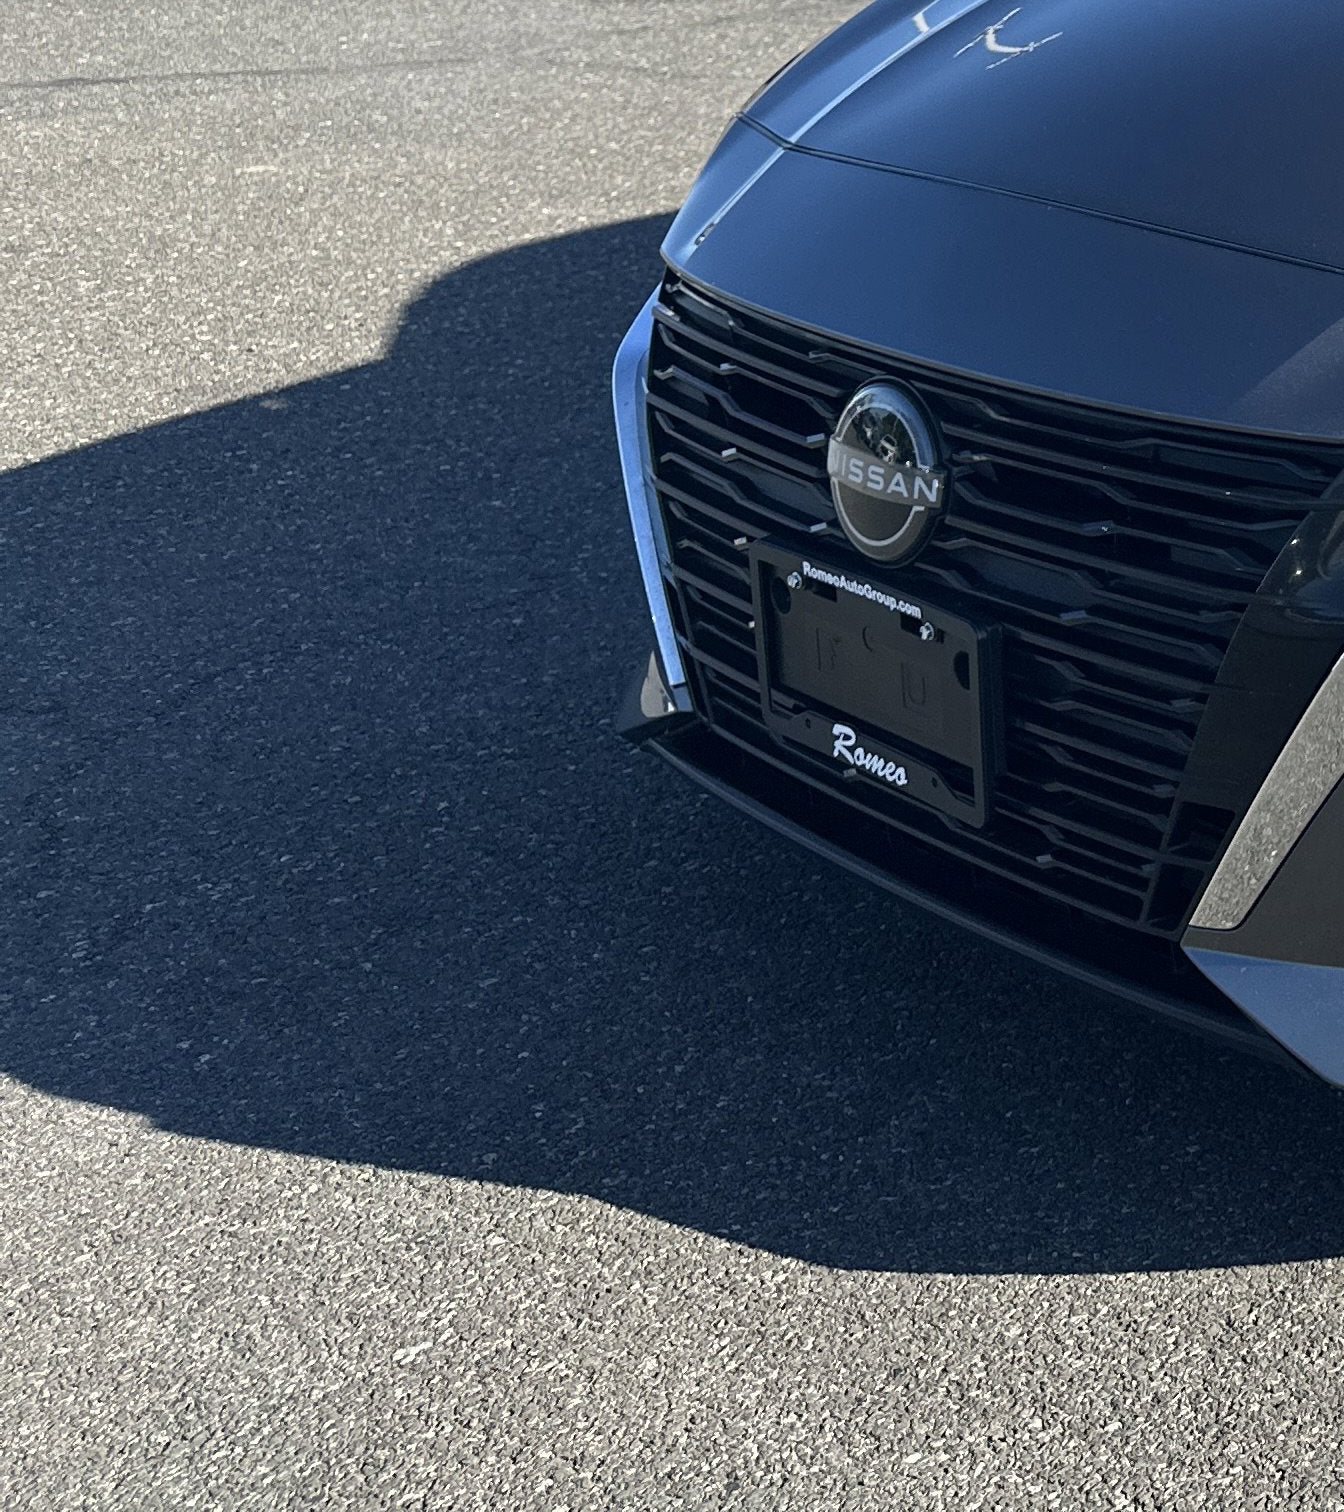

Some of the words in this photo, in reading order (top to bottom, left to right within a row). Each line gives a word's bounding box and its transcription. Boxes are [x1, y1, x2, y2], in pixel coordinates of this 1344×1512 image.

[832, 449, 940, 503] NISSAN
[802, 560, 922, 620] RomeoAutoGroup.com
[832, 723, 908, 786] Romeo
